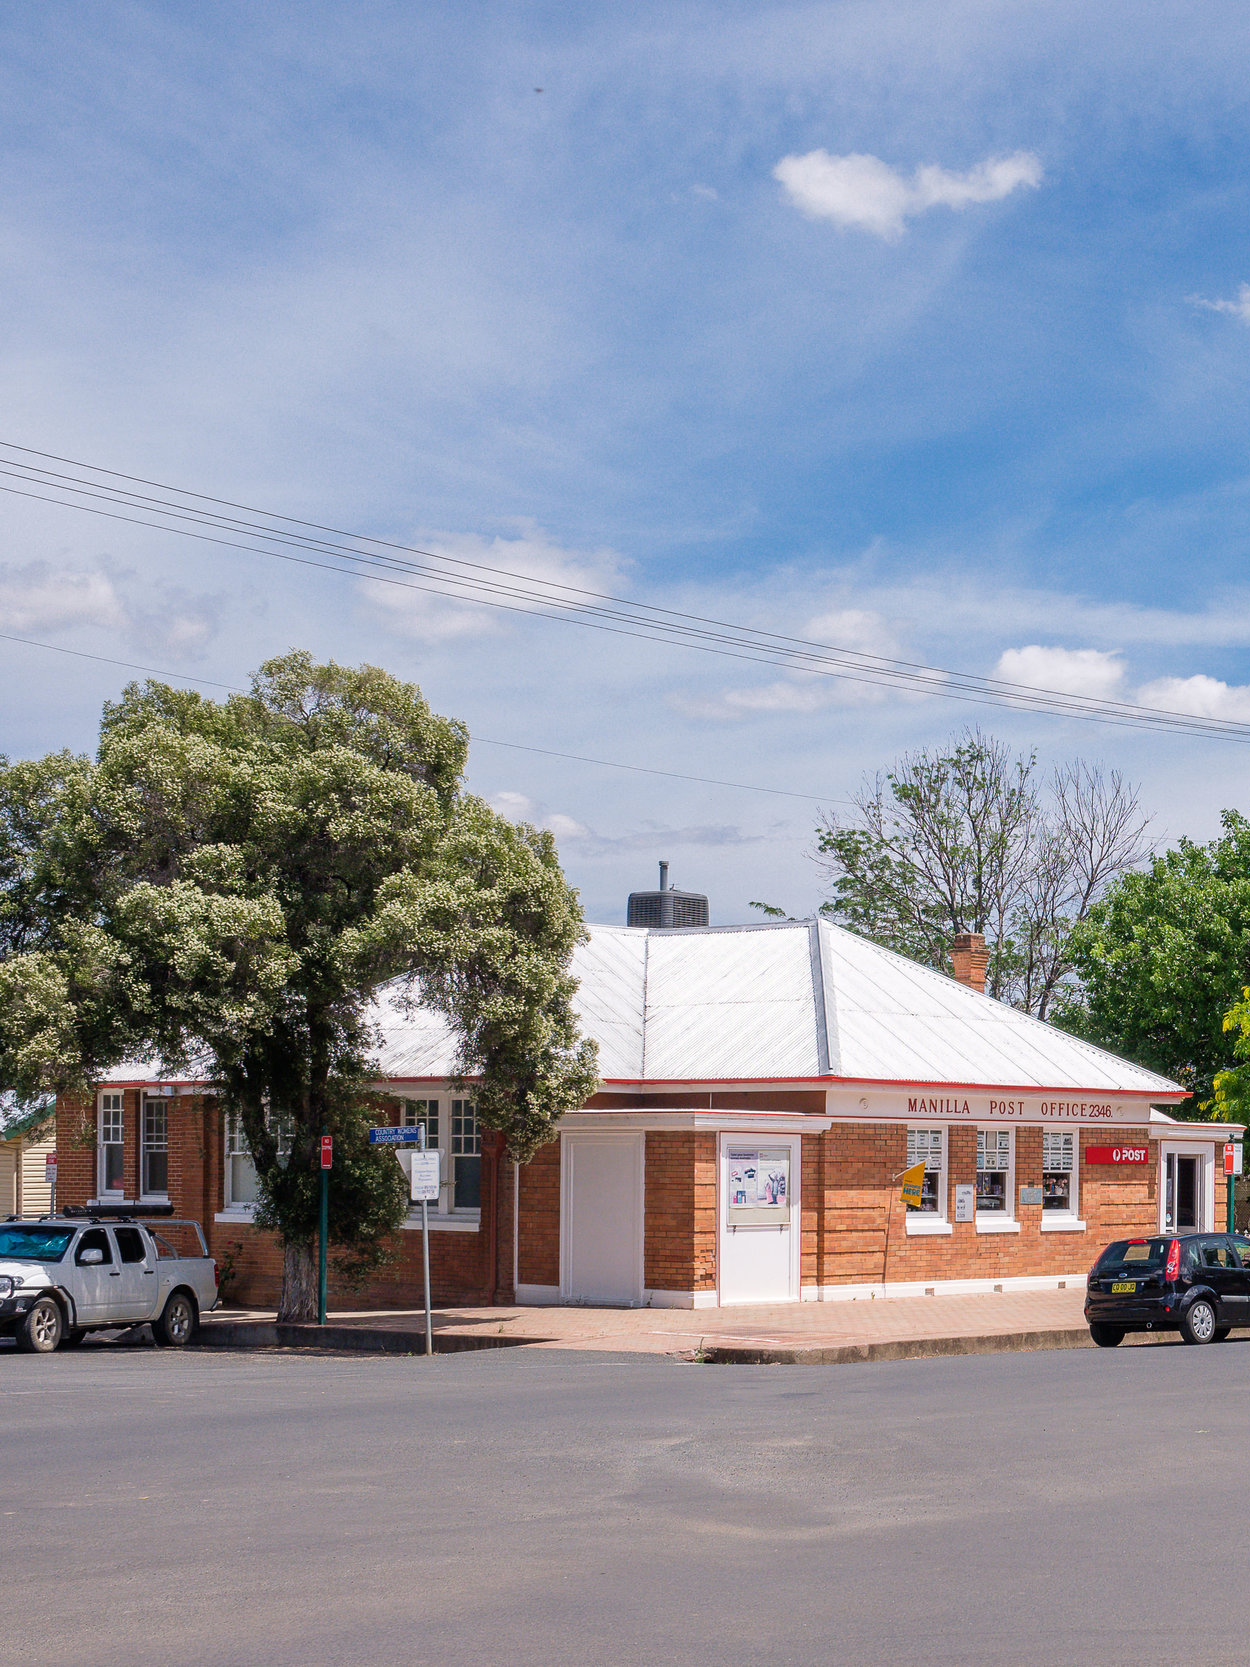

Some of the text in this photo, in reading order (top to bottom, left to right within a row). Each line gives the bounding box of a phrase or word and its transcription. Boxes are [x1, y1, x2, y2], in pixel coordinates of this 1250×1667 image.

[908, 1098, 970, 1114] MANILLA
[990, 1100, 1025, 1116] POST
[1041, 1102, 1087, 1117] OFFICE
[1122, 1150, 1146, 1161] POST
[903, 1186, 921, 1197] HERE
